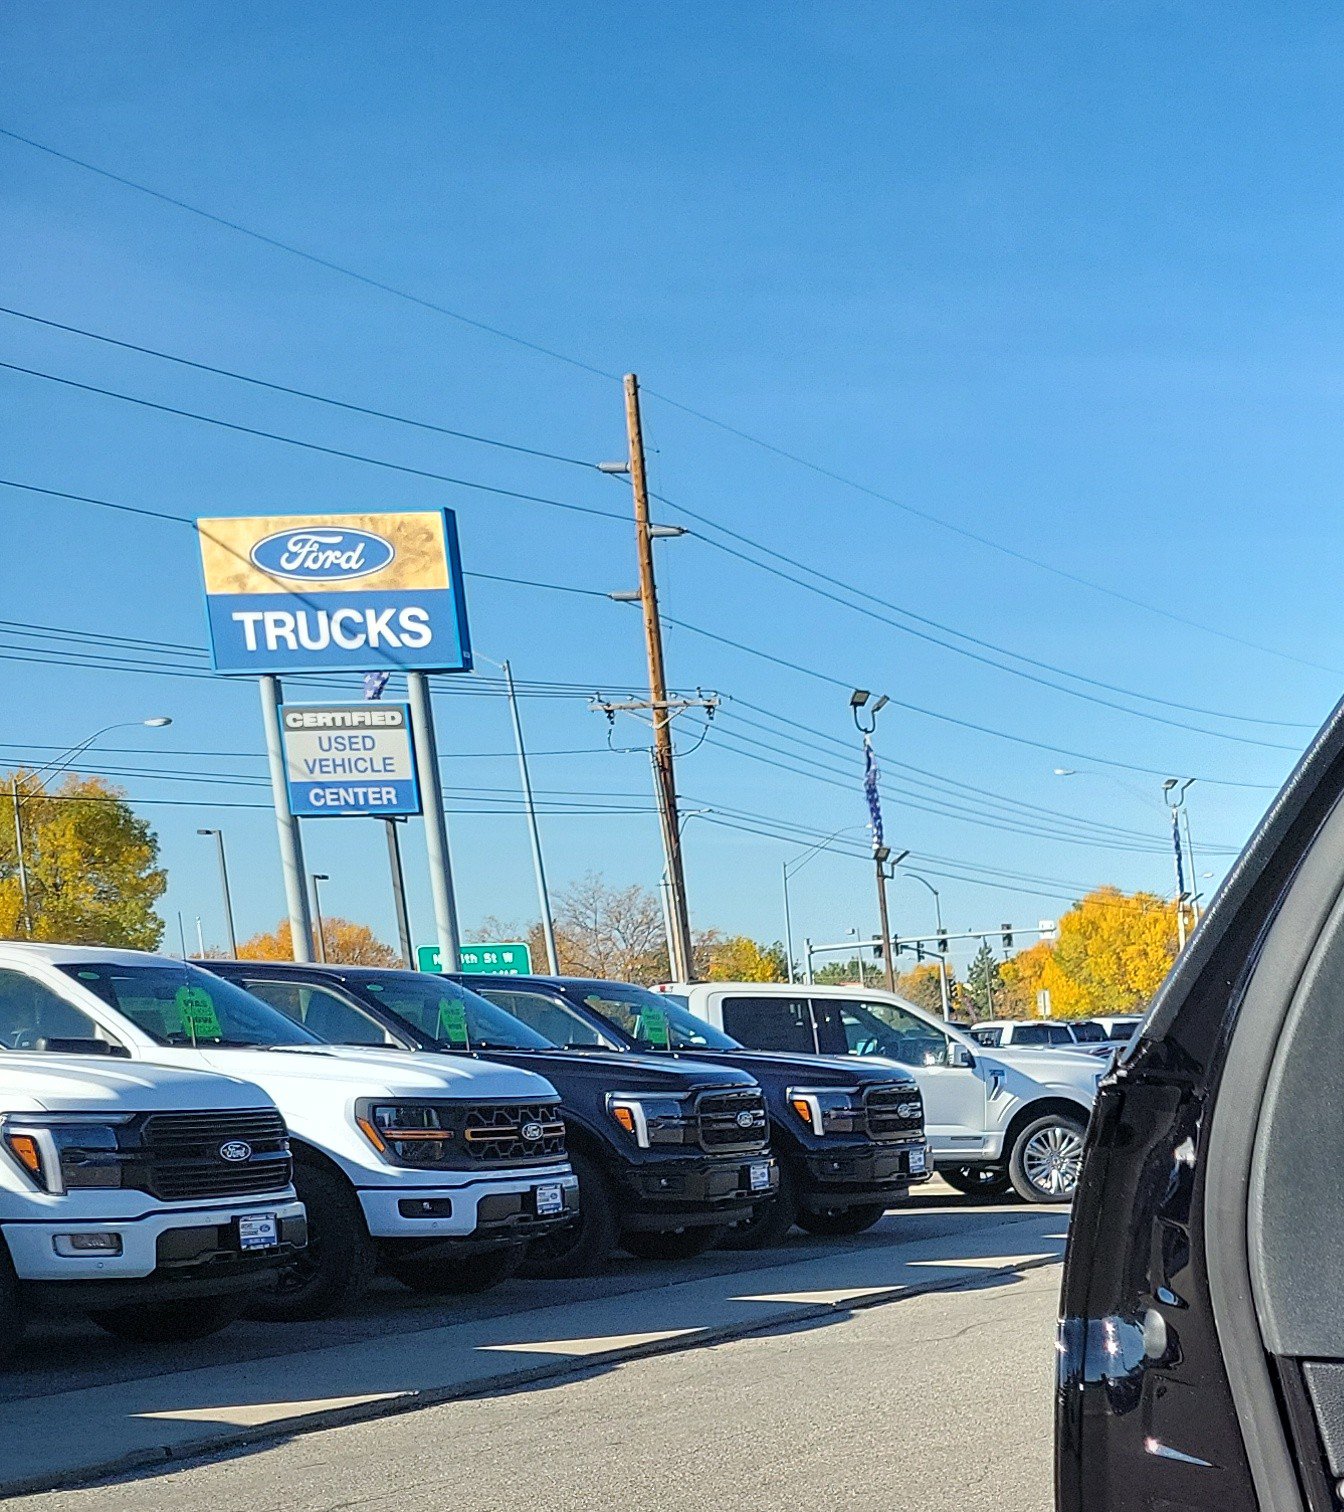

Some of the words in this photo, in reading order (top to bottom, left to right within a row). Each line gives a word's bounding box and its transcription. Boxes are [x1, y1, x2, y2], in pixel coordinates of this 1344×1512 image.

[280, 534, 366, 571] Ford
[232, 607, 433, 652] TRUCKS
[285, 710, 403, 729] CERTIFIED
[318, 735, 376, 753] USED
[304, 756, 395, 775] VEHICLE
[309, 787, 398, 807] CENTER
